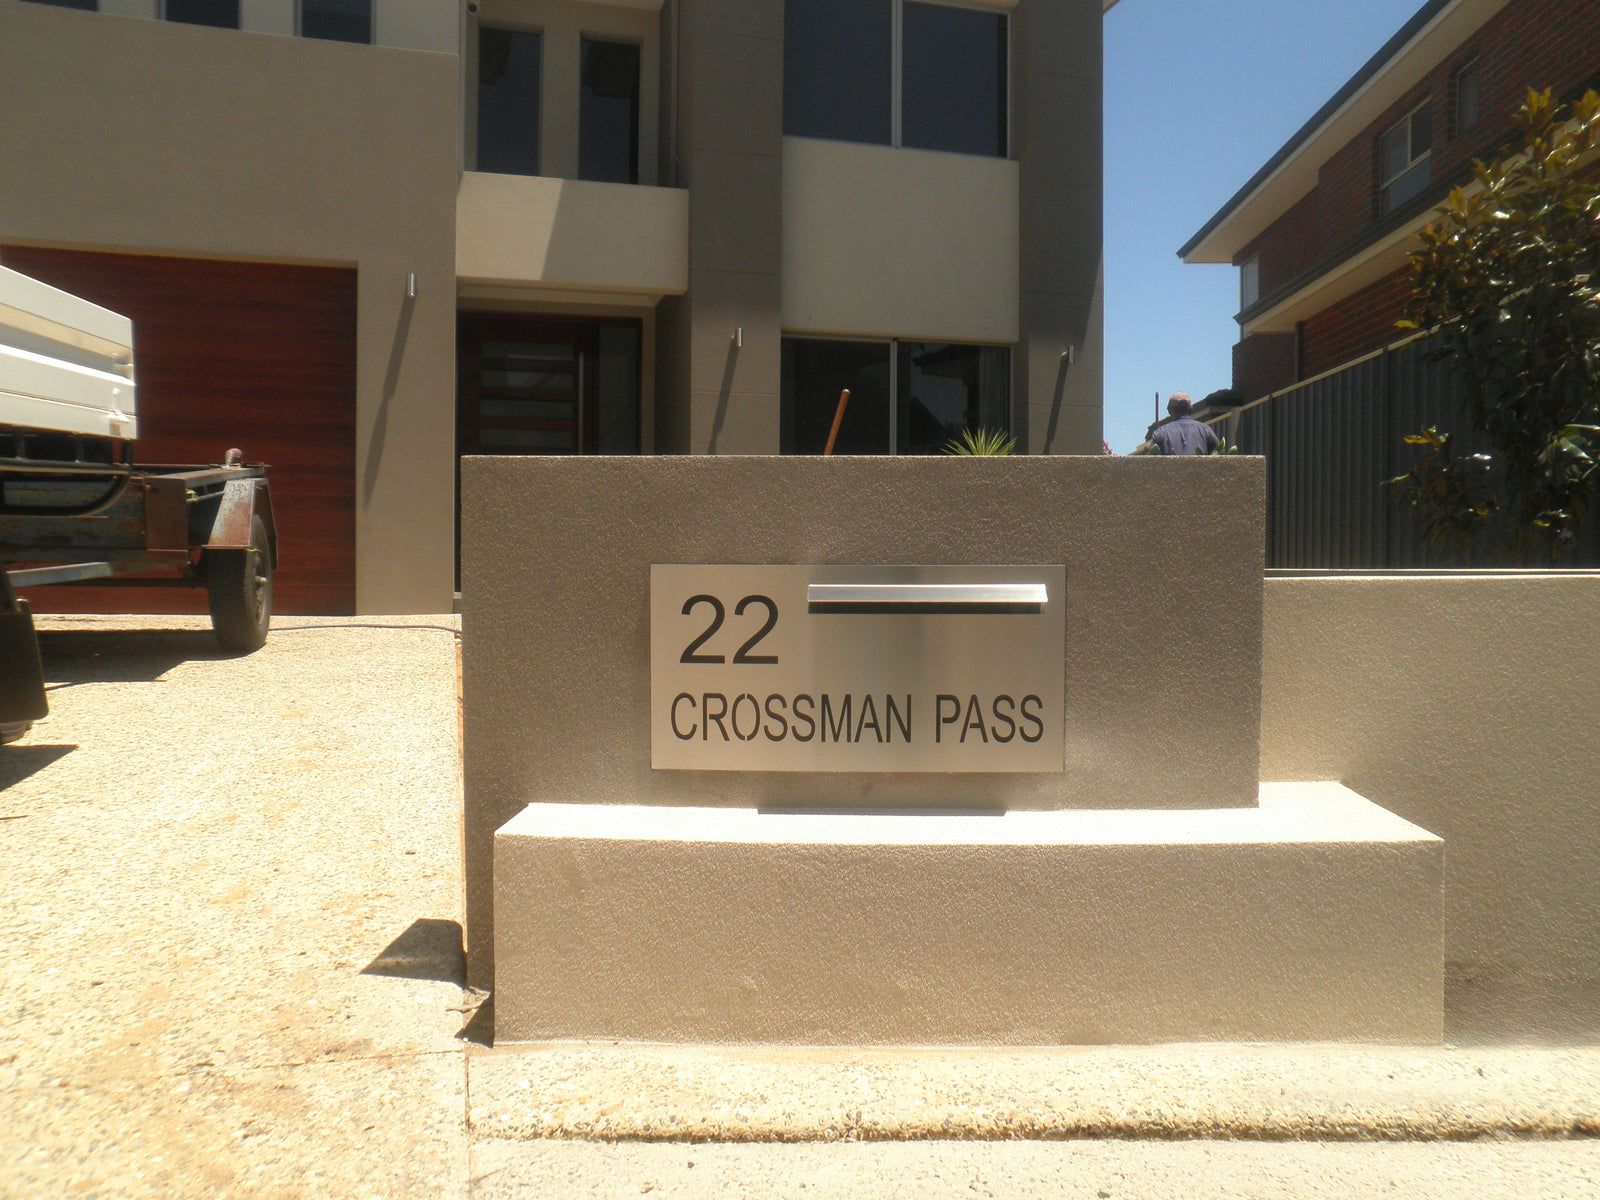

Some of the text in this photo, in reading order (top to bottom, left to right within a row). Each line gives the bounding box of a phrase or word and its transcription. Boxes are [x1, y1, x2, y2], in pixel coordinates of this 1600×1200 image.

[679, 594, 779, 665] 22
[670, 692, 1044, 744] CROSSMAN PASS
